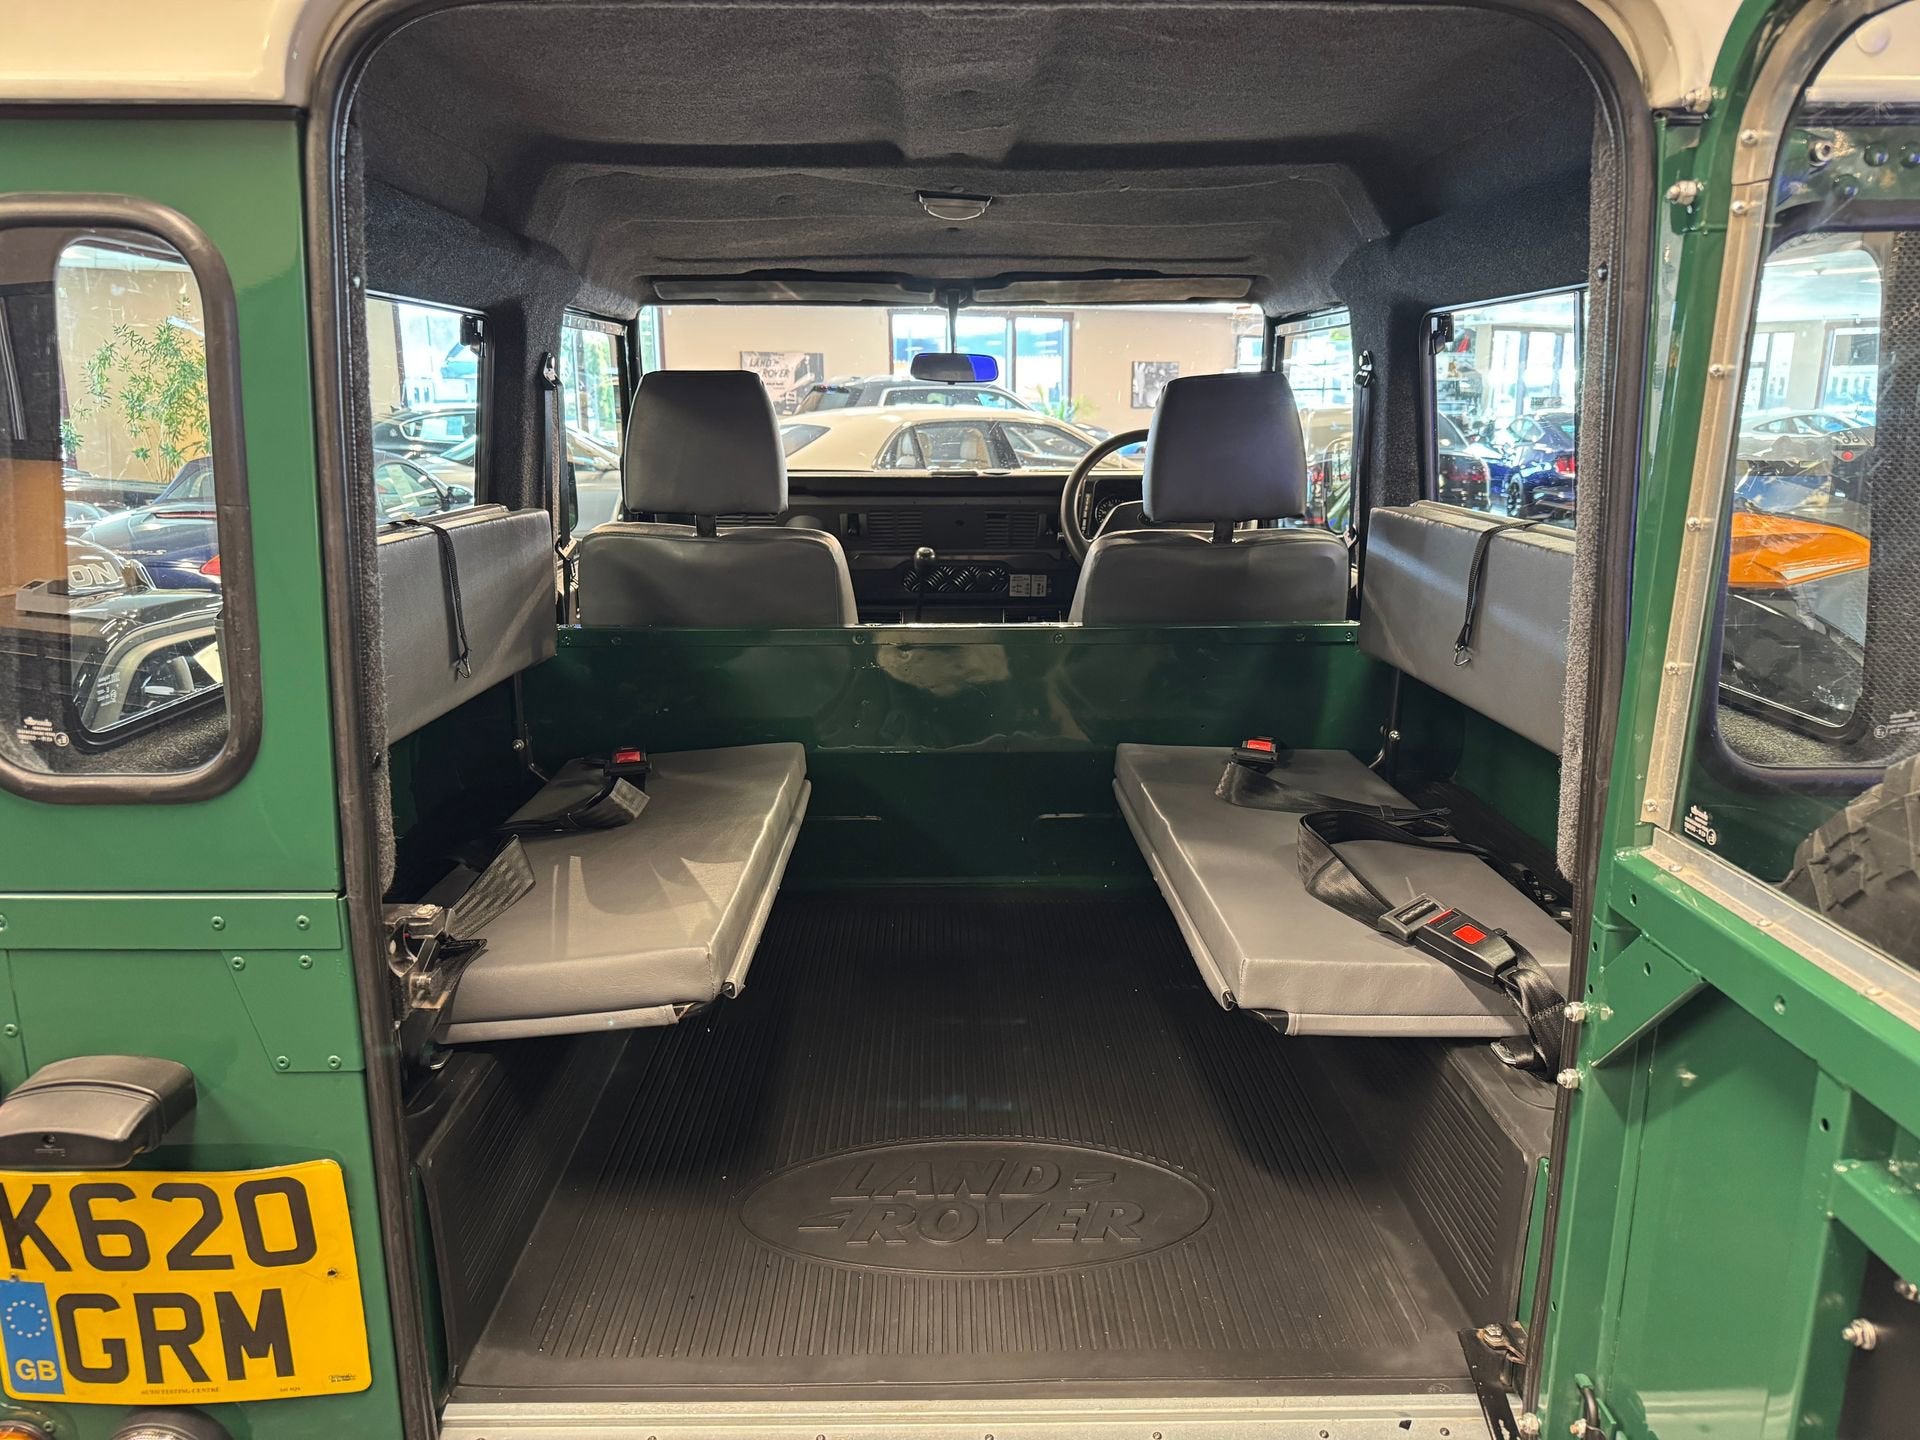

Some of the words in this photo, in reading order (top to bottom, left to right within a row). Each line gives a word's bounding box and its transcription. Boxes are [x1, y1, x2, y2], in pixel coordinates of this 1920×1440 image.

[749, 359, 772, 368] LAND
[762, 368, 789, 378] ROVER
[830, 1159, 1061, 1200] LAND
[0, 1176, 317, 1272] K620
[846, 1201, 1145, 1246] ROVER
[56, 1288, 295, 1384] GRM
[15, 1358, 57, 1381] GB
